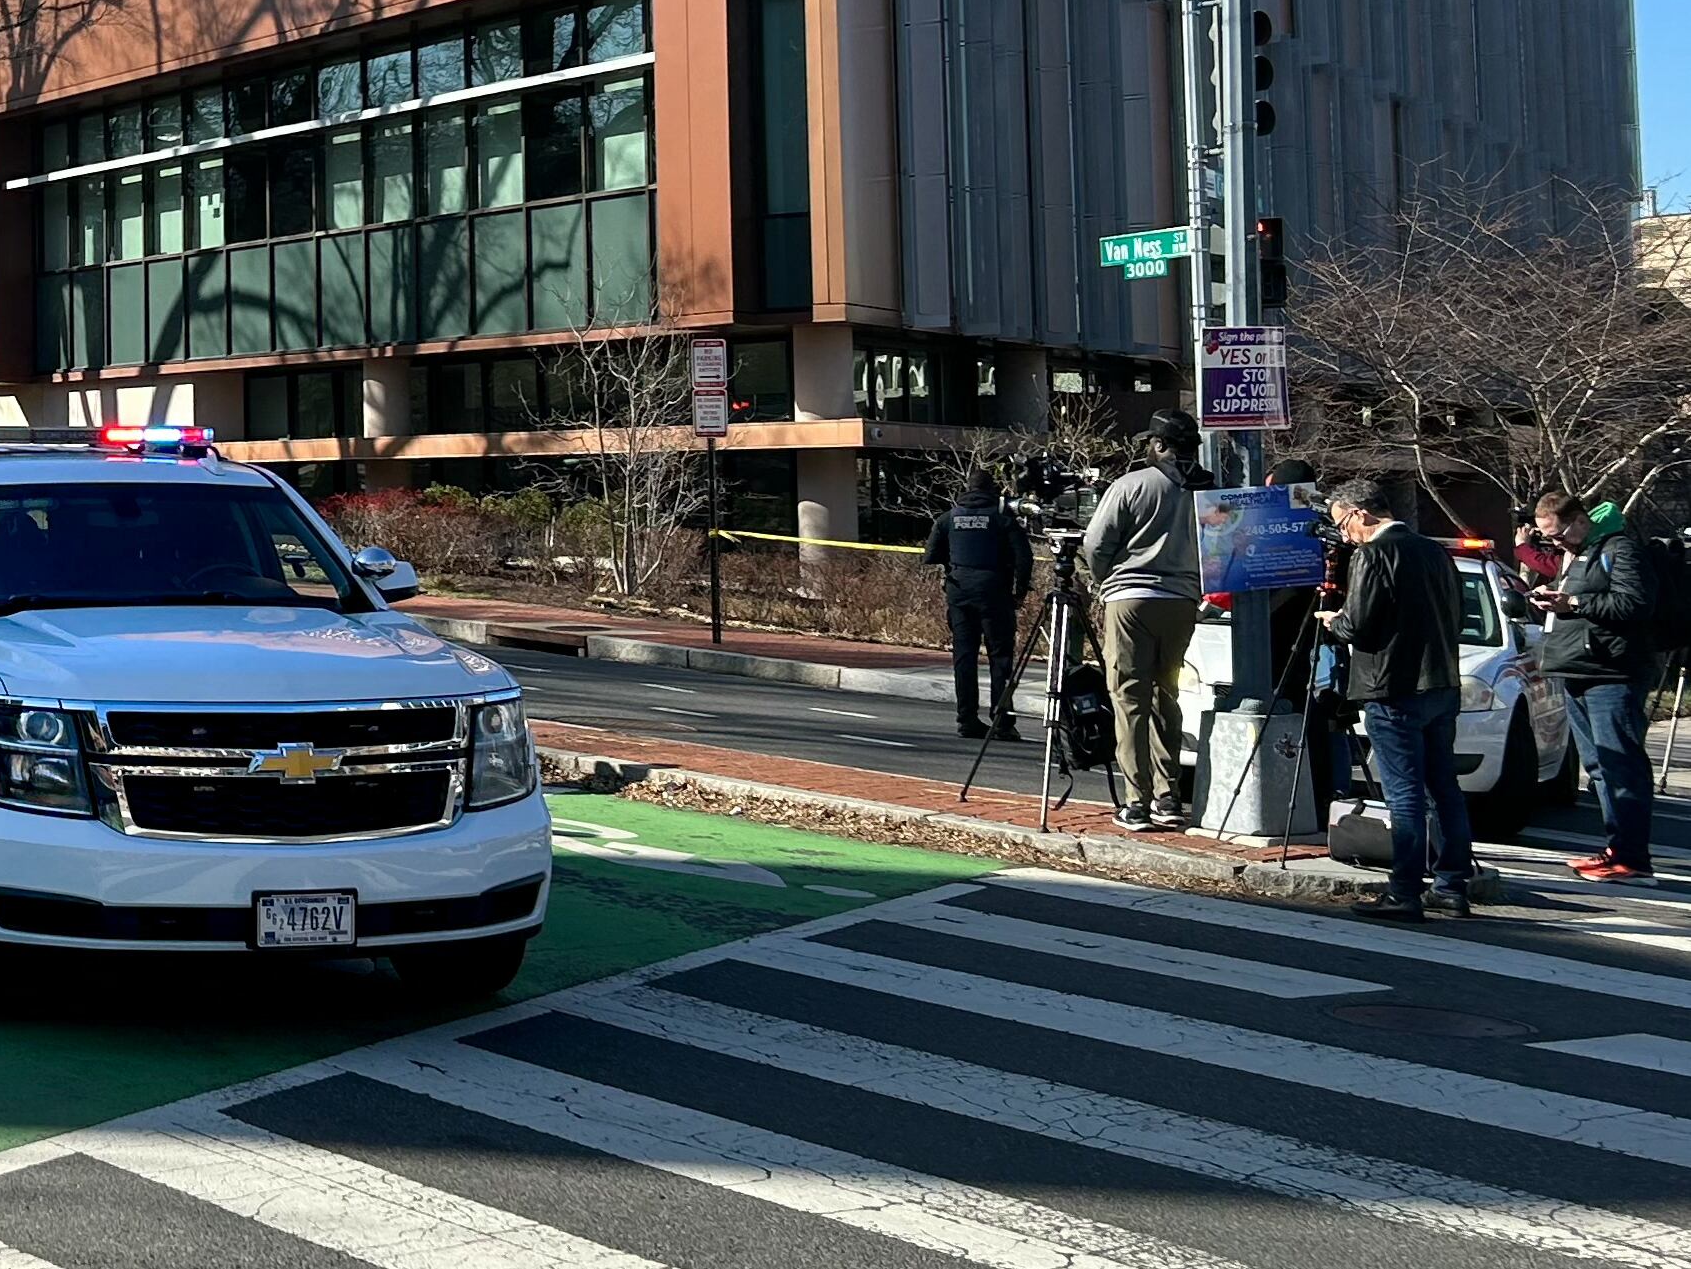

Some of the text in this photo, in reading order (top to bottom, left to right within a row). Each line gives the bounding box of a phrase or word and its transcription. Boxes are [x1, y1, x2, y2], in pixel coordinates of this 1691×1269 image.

[1105, 232, 1185, 261] Van Ness ST
[1126, 259, 1165, 278] 3000
[1218, 331, 1238, 344] Sign
[1239, 331, 1255, 342] the
[1220, 348, 1251, 365] YES
[1225, 383, 1247, 397] DC
[954, 522, 988, 530] POLICE
[1245, 522, 1308, 536] 240-505-57
[286, 905, 344, 932] 4762V
